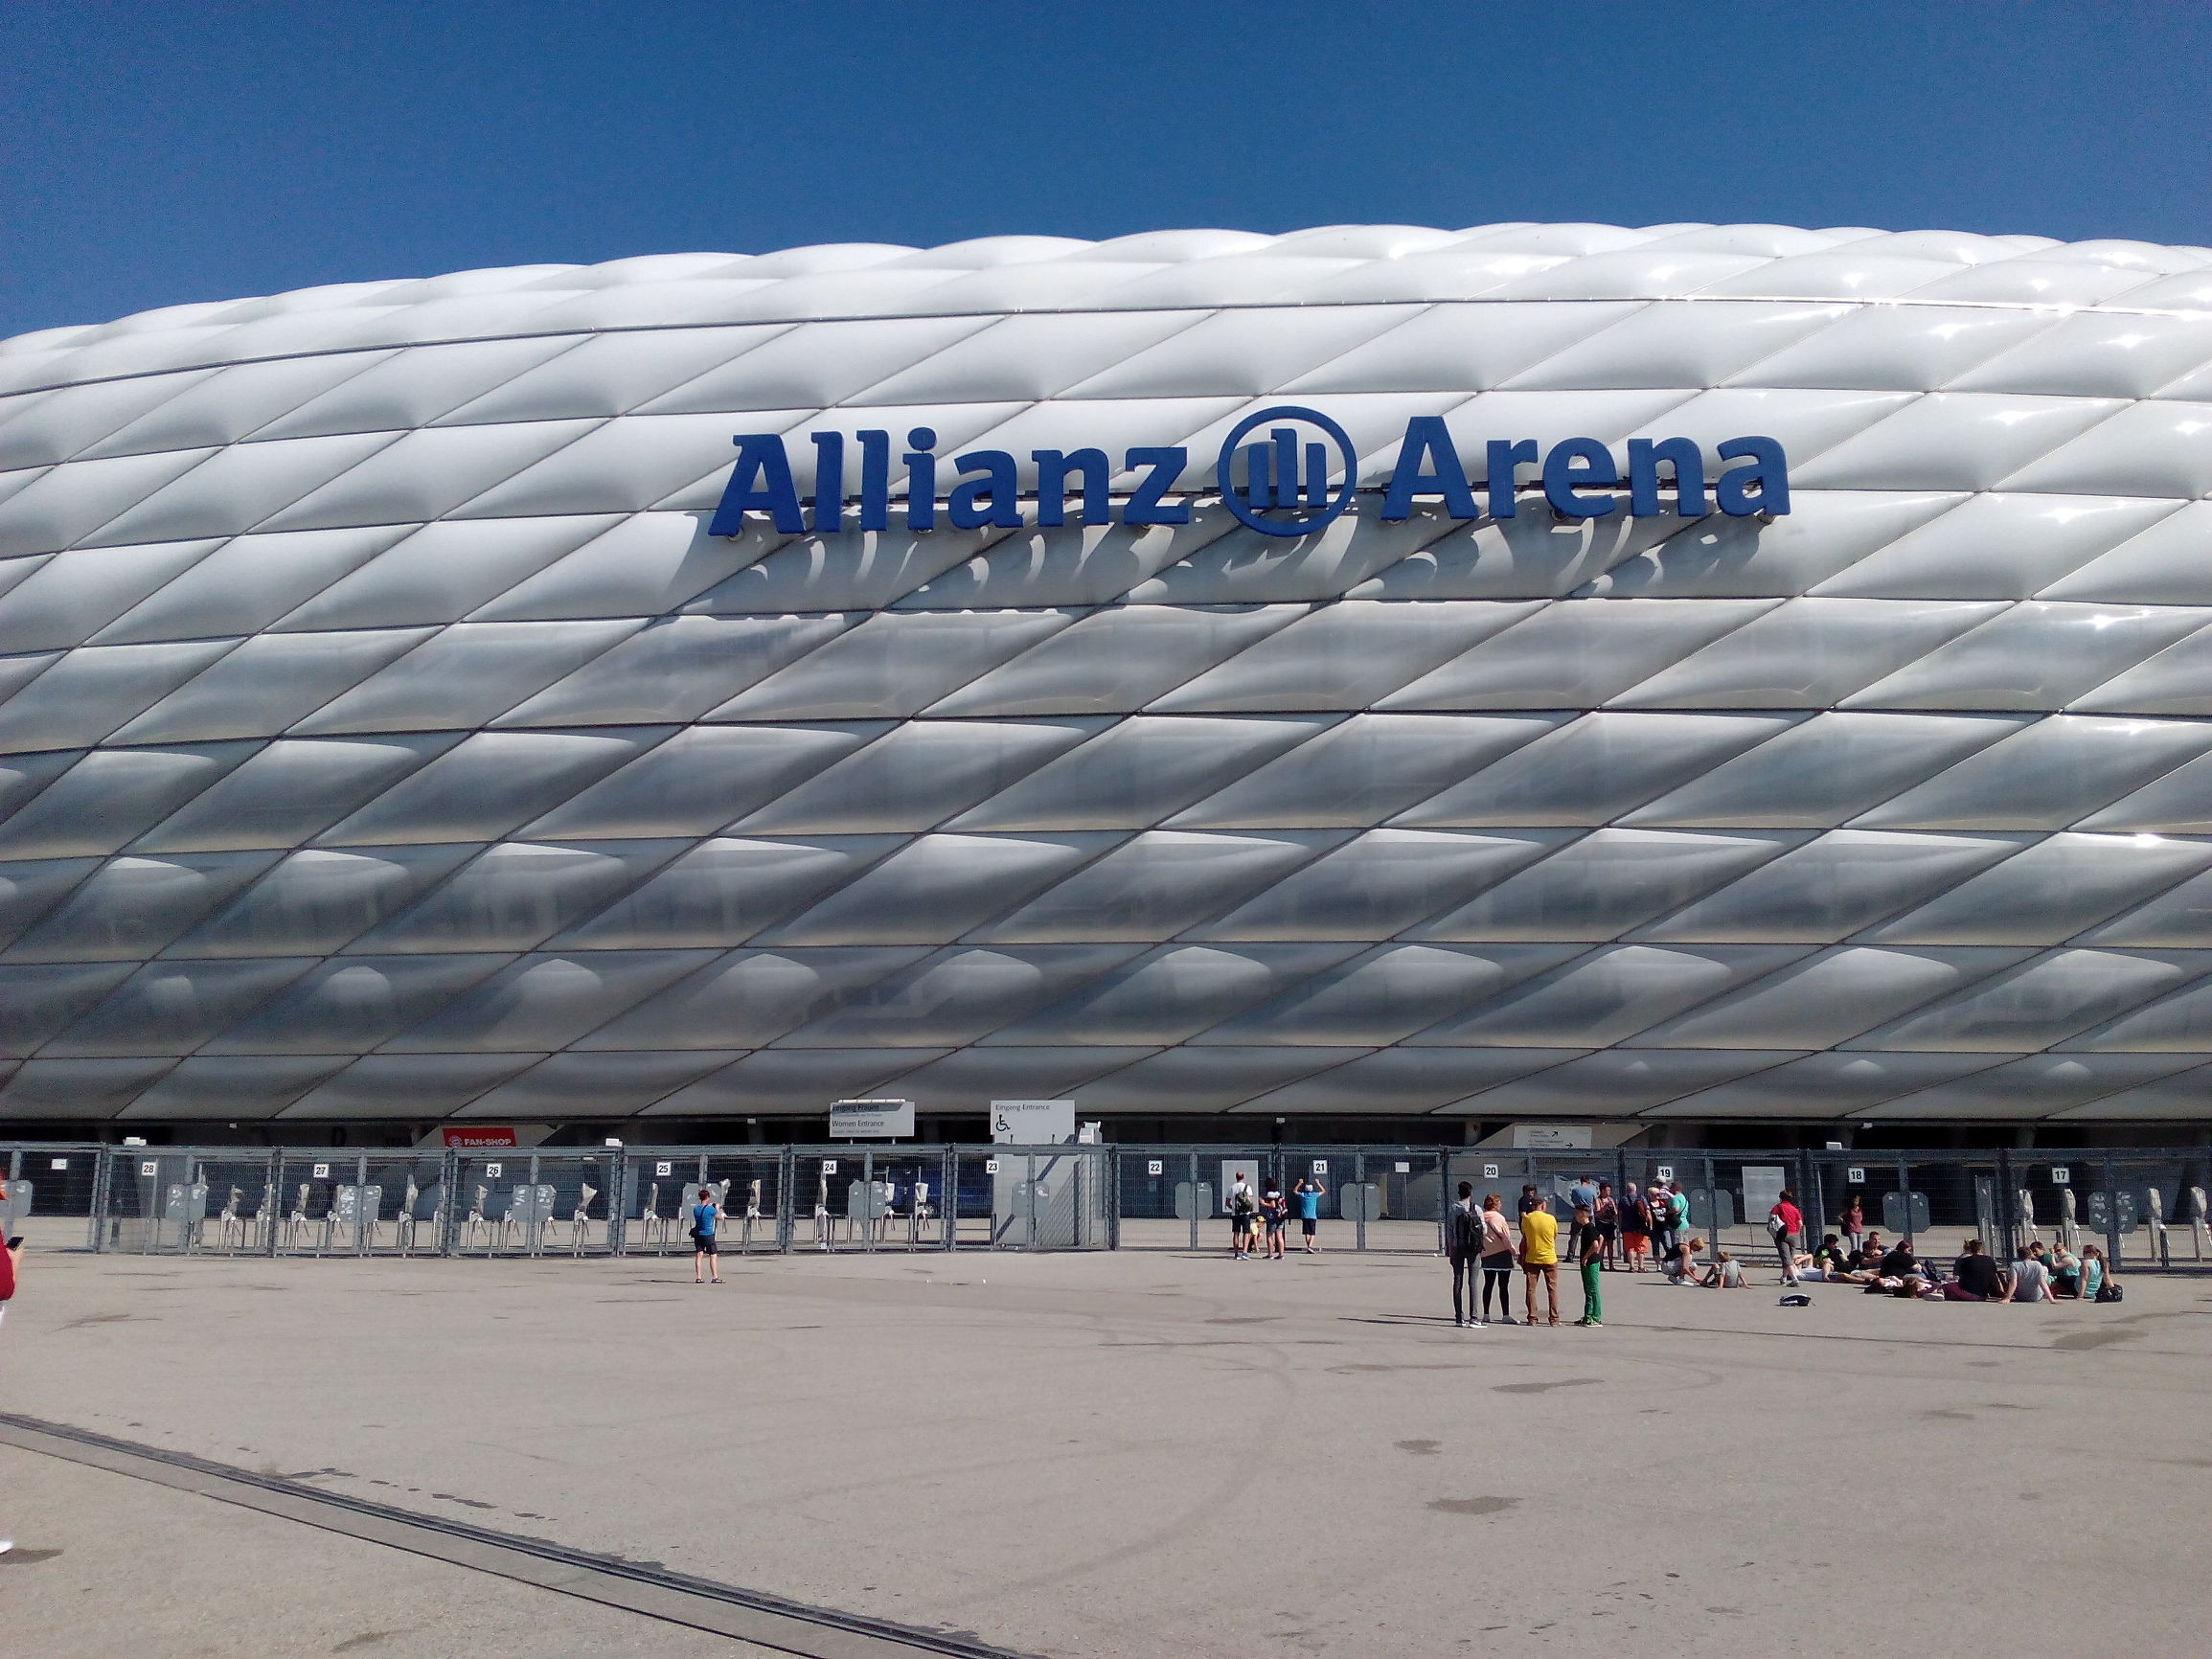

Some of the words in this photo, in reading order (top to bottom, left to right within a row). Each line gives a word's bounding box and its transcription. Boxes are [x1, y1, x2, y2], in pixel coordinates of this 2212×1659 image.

[708, 427, 1189, 536] Allianz
[1380, 416, 1790, 520] Arena
[143, 1164, 154, 1173] 28
[315, 1167, 326, 1175] 27
[488, 1166, 499, 1175] 26
[658, 1164, 669, 1173] 25
[824, 1163, 834, 1171] 24
[988, 1162, 998, 1171] 23
[1150, 1163, 1160, 1171] 22
[1315, 1163, 1325, 1171] 21
[1485, 1167, 1496, 1175] 20
[1659, 1169, 1671, 1177] 19
[1850, 1170, 1862, 1179] 18
[2054, 1170, 2066, 1179] 17
